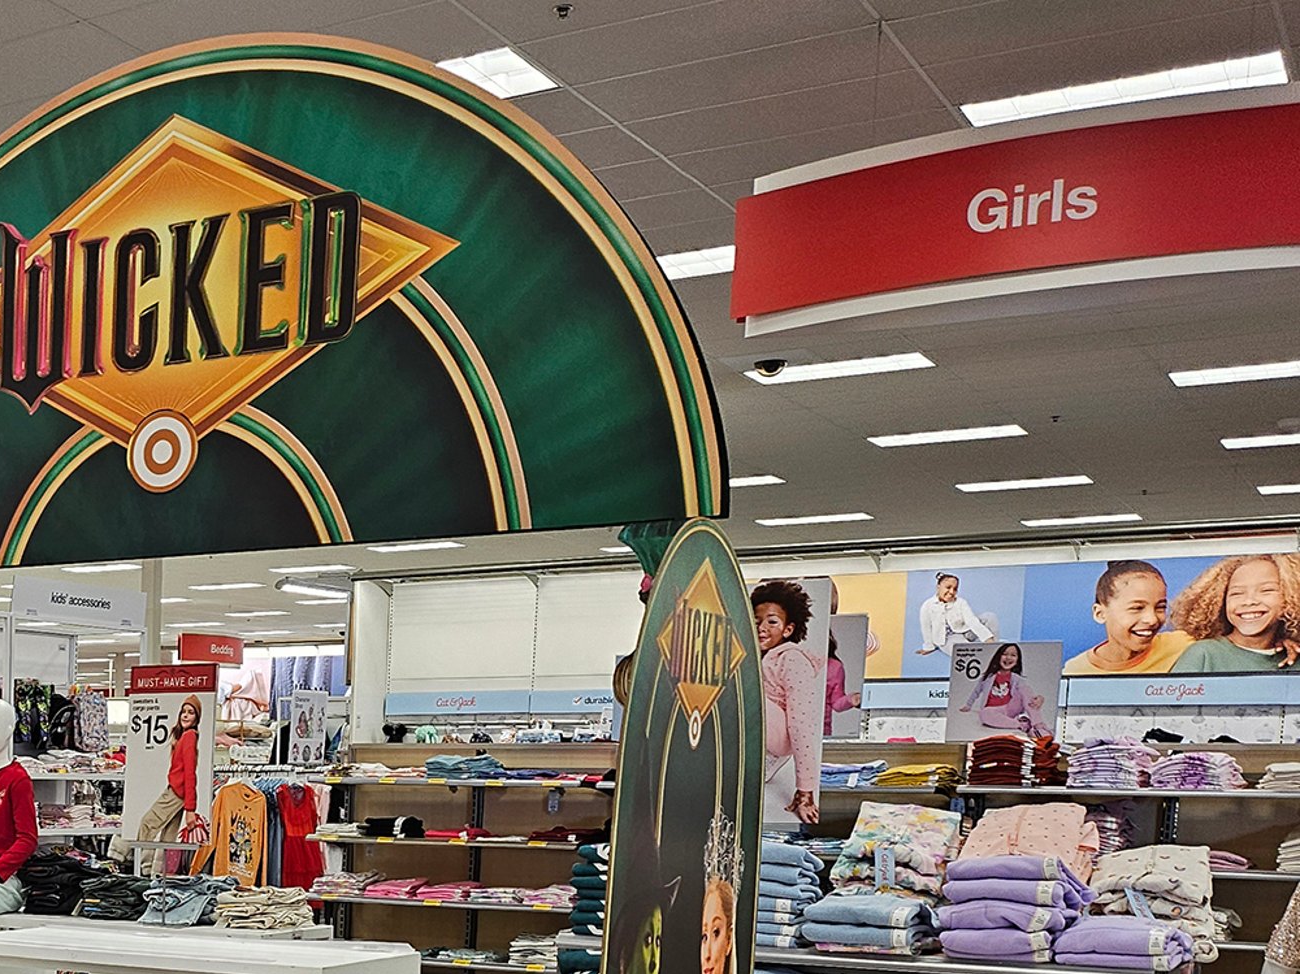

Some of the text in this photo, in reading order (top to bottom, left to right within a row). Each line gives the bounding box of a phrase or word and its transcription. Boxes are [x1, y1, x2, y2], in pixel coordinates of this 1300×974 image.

[966, 178, 1098, 233] Girls
[51, 591, 112, 610] kids' accessories
[210, 643, 234, 657] Bedding
[955, 654, 981, 680] $6
[137, 675, 209, 688] MUST-HAVE GIFT
[928, 689, 950, 698] kids
[1144, 683, 1205, 702] Cat & Jack
[130, 713, 169, 745] $15
